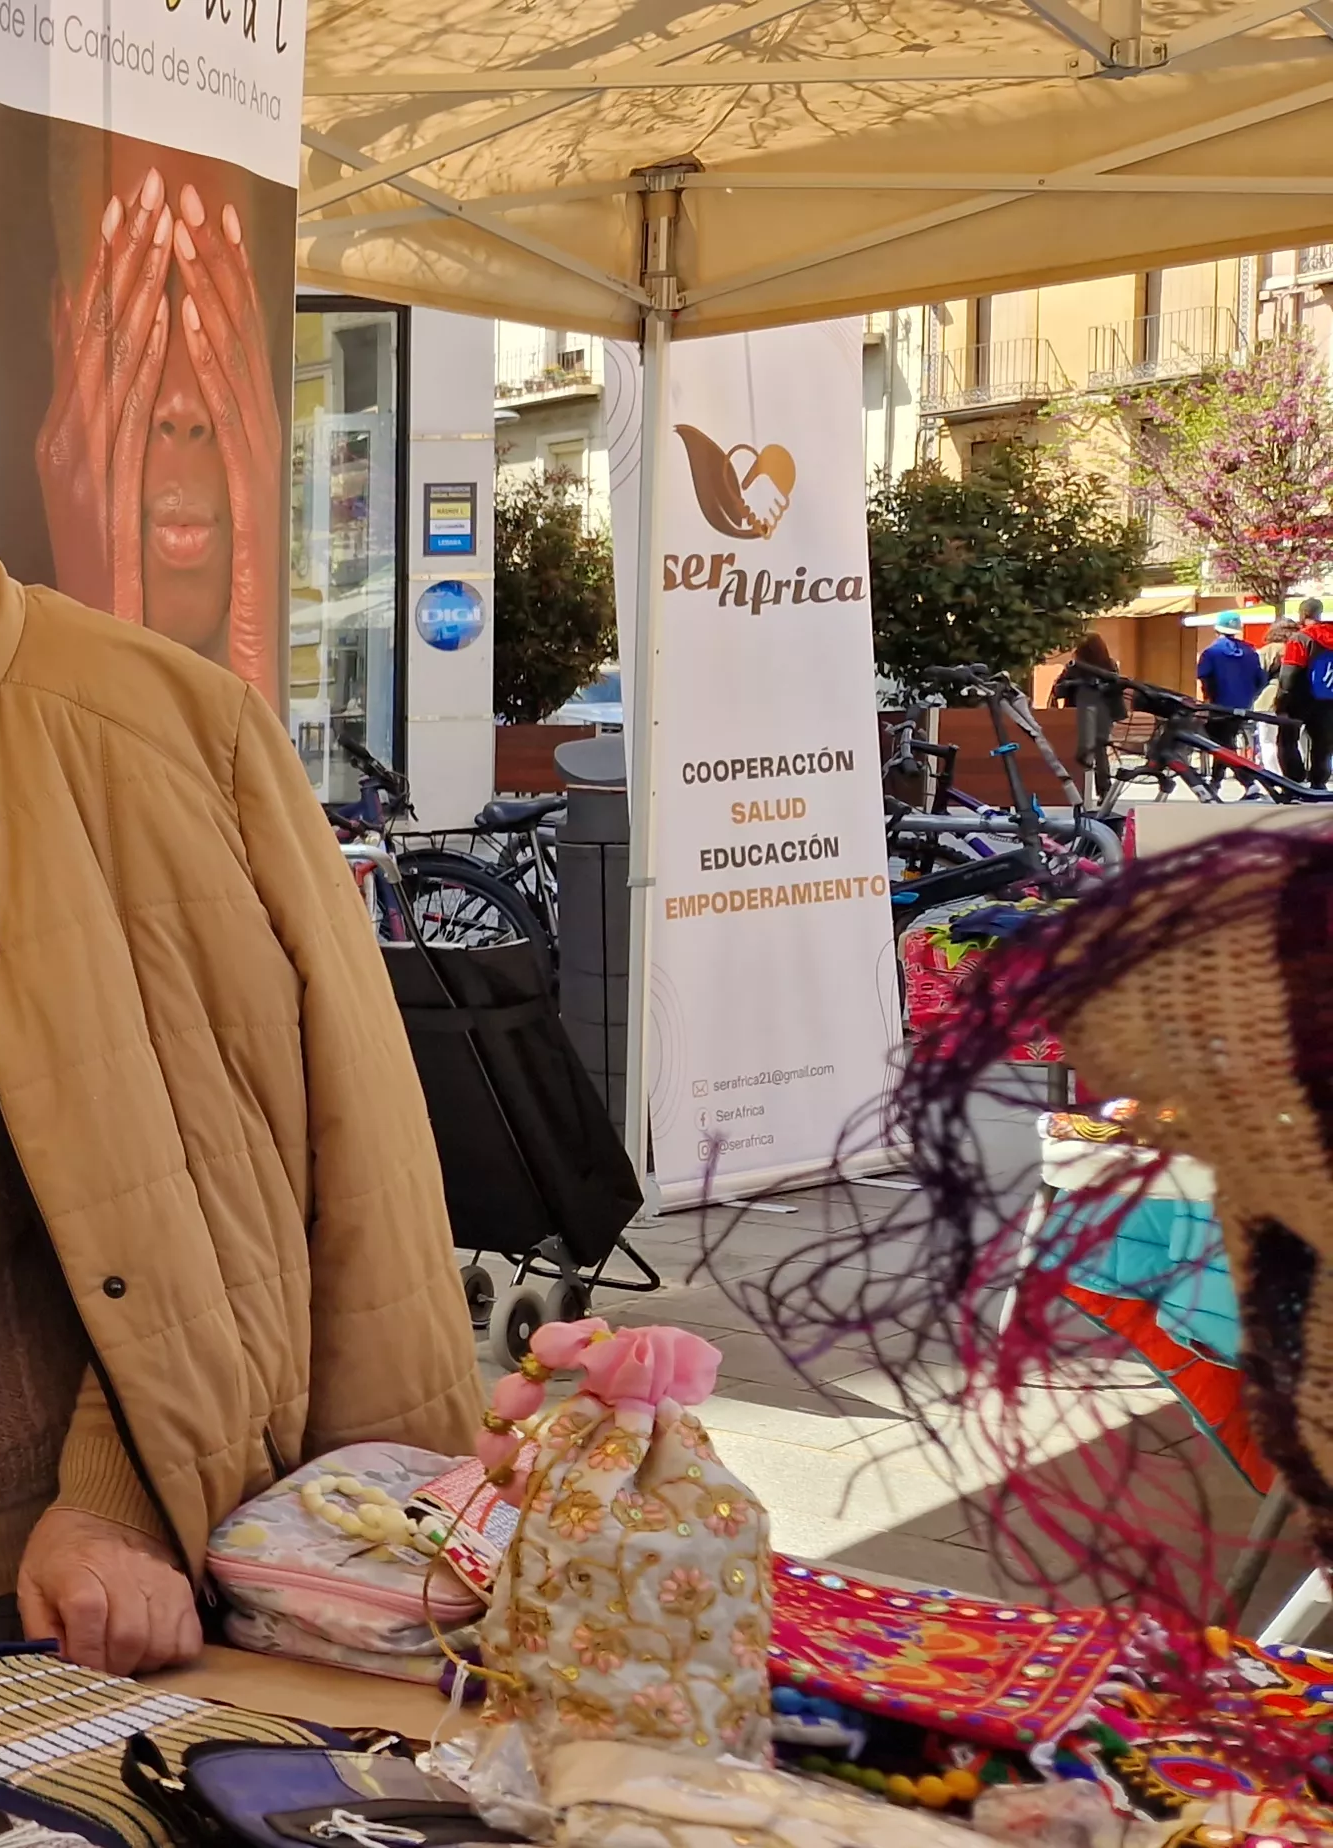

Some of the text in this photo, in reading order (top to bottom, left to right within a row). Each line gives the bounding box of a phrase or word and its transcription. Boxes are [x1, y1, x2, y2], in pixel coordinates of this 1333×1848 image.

[0, 0, 25, 38] de
[33, 3, 55, 47] la
[64, 15, 155, 76] Caridad
[162, 47, 189, 87] de
[196, 56, 247, 108] Santa
[249, 80, 282, 122] Ana
[682, 747, 854, 785] COOPERACIÓN
[731, 797, 807, 824] SALUD
[700, 833, 839, 871] EDUCACIÓN
[665, 875, 886, 920] EMPODERAMIENTO
[713, 1064, 835, 1092] serafrica21@gmail.com
[716, 1104, 765, 1123] SerAfrica
[717, 1133, 774, 1155] @serafrica
